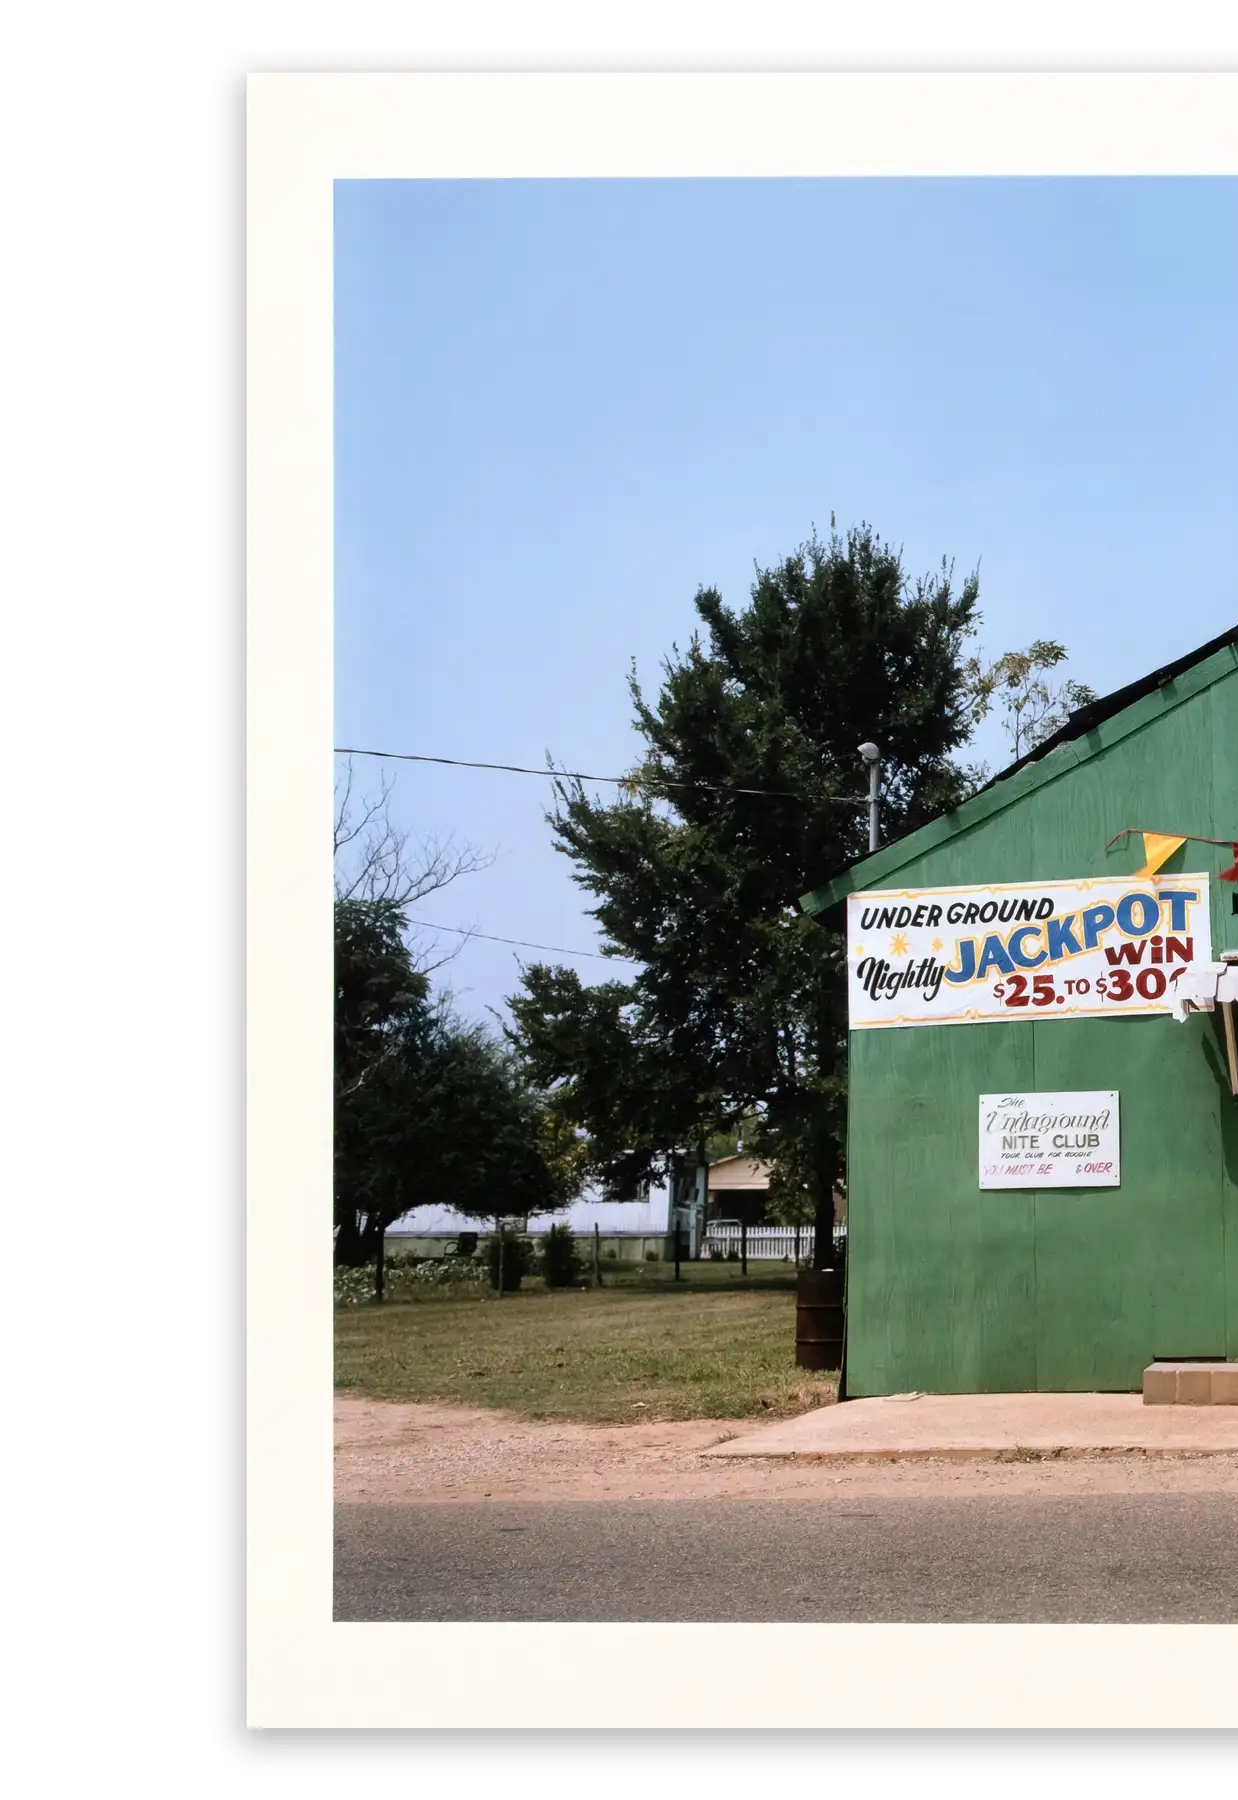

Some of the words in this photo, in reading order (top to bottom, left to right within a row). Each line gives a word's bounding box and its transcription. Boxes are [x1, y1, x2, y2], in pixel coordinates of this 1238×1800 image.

[860, 903, 942, 931] UNDER
[946, 897, 1055, 925] GROUND
[856, 956, 945, 1002] Nightly
[943, 889, 1198, 984] JACKPOT
[993, 974, 1066, 1007] $25.
[1064, 978, 1091, 995] TO
[985, 1109, 1110, 1135] Underground
[1002, 1135, 1040, 1150] NITE
[1052, 1133, 1100, 1149] CLUB
[1004, 1164, 1035, 1175] MUST
[1037, 1163, 1053, 1175] BE
[1084, 1162, 1113, 1173] OVER
